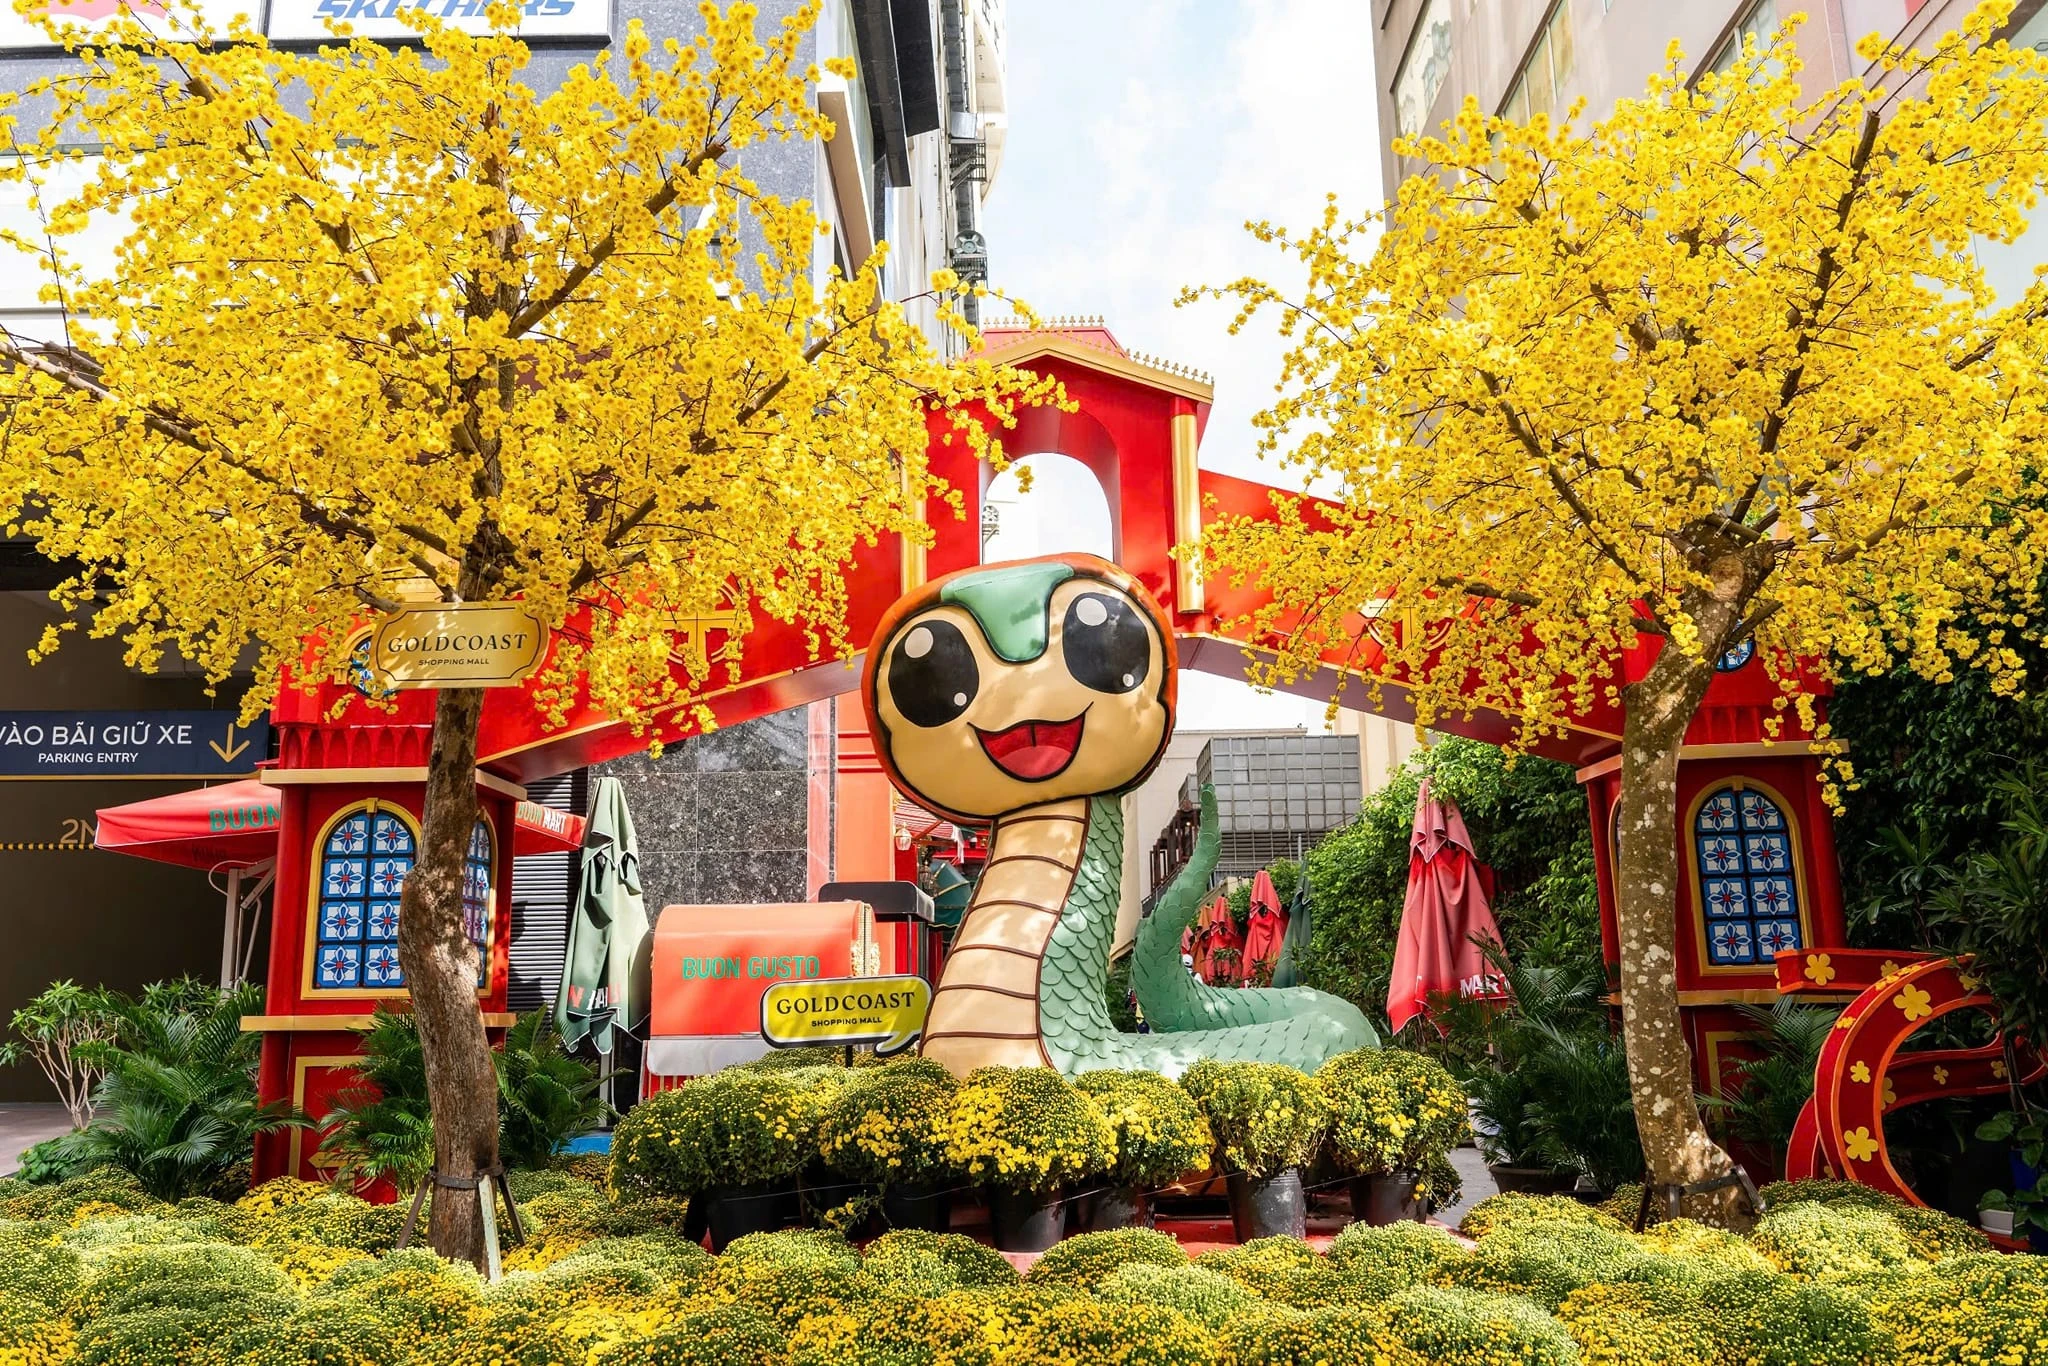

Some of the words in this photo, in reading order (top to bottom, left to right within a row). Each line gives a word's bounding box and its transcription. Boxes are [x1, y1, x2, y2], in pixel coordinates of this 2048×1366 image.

[312, 0, 576, 19] SKECHRS
[388, 633, 529, 653] GOLDCOAST
[418, 658, 465, 666] SHOPPING
[52, 721, 95, 746] BÃI
[102, 721, 152, 746] GIỮ
[157, 725, 193, 745] XE
[38, 752, 94, 764] PARKING
[96, 752, 139, 763] ENTRY
[209, 803, 281, 833] BUON
[542, 806, 567, 835] MART
[682, 956, 740, 980] BUON
[747, 955, 820, 979] GUSTO
[776, 991, 916, 1015] GOLDCOAST
[811, 1018, 858, 1027] SHOPPING
[859, 1016, 883, 1026] MALL
